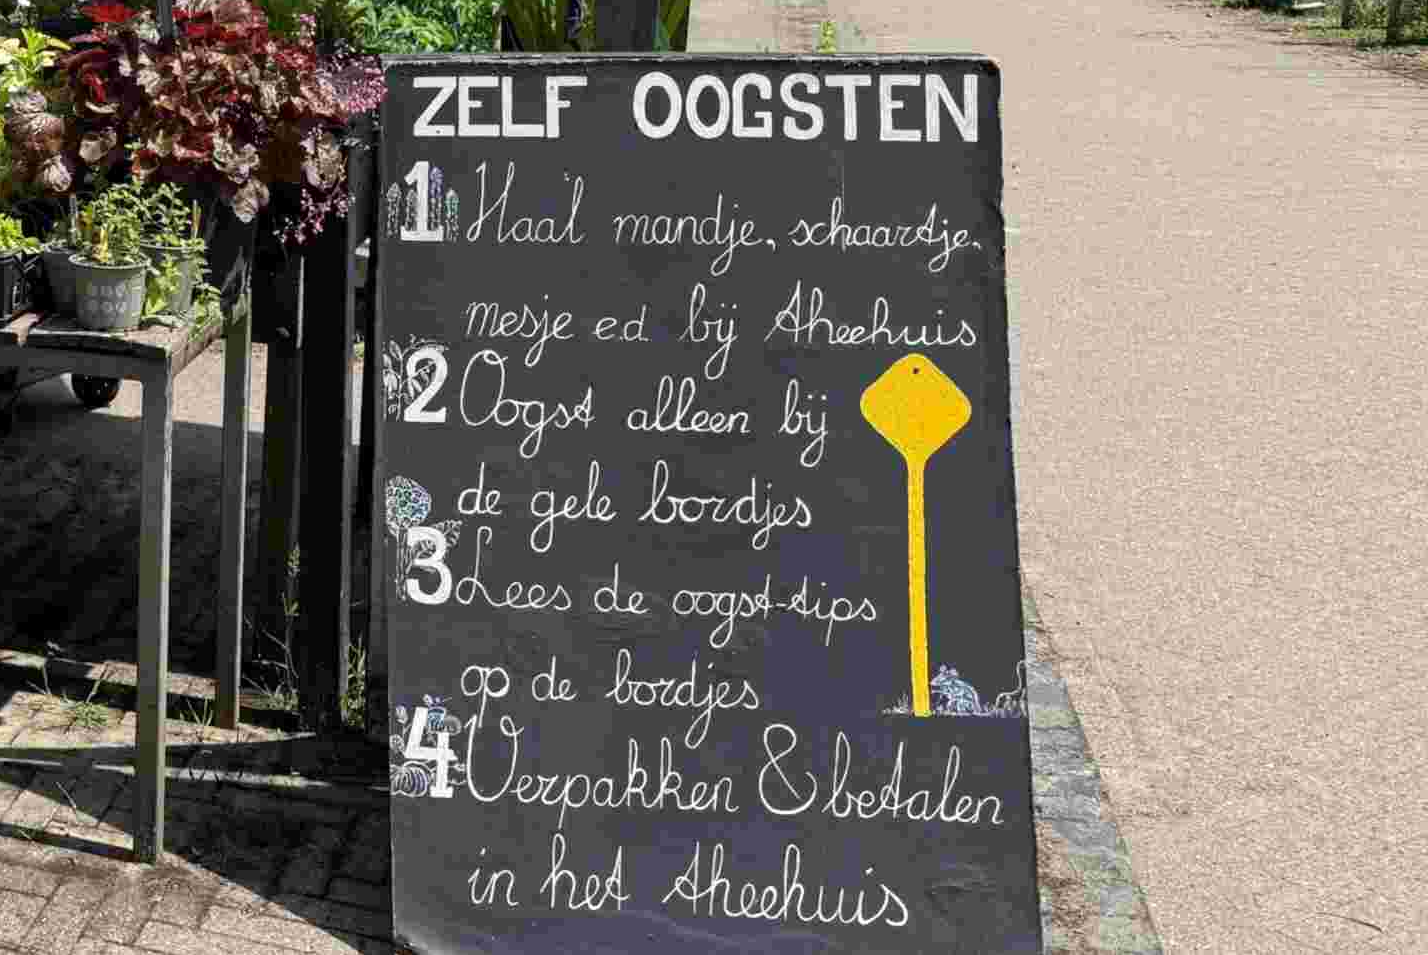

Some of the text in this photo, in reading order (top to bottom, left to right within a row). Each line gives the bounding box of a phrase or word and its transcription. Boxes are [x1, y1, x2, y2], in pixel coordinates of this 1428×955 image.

[412, 71, 979, 143] ZELF OOGSTEN
[400, 161, 445, 242] 1
[467, 161, 586, 244] Haal
[613, 193, 776, 276] mandje,
[465, 294, 575, 367] mesje
[677, 282, 740, 381] bij
[403, 347, 829, 467] 2 Oogst alleen bij
[458, 459, 812, 552] de gele bordjes
[405, 525, 877, 648] 3 Lees de oogst-tips
[461, 648, 760, 749] op de bordjes
[403, 705, 1004, 828] 4 Verpakken & betalen
[467, 833, 909, 927] in het theehuis
